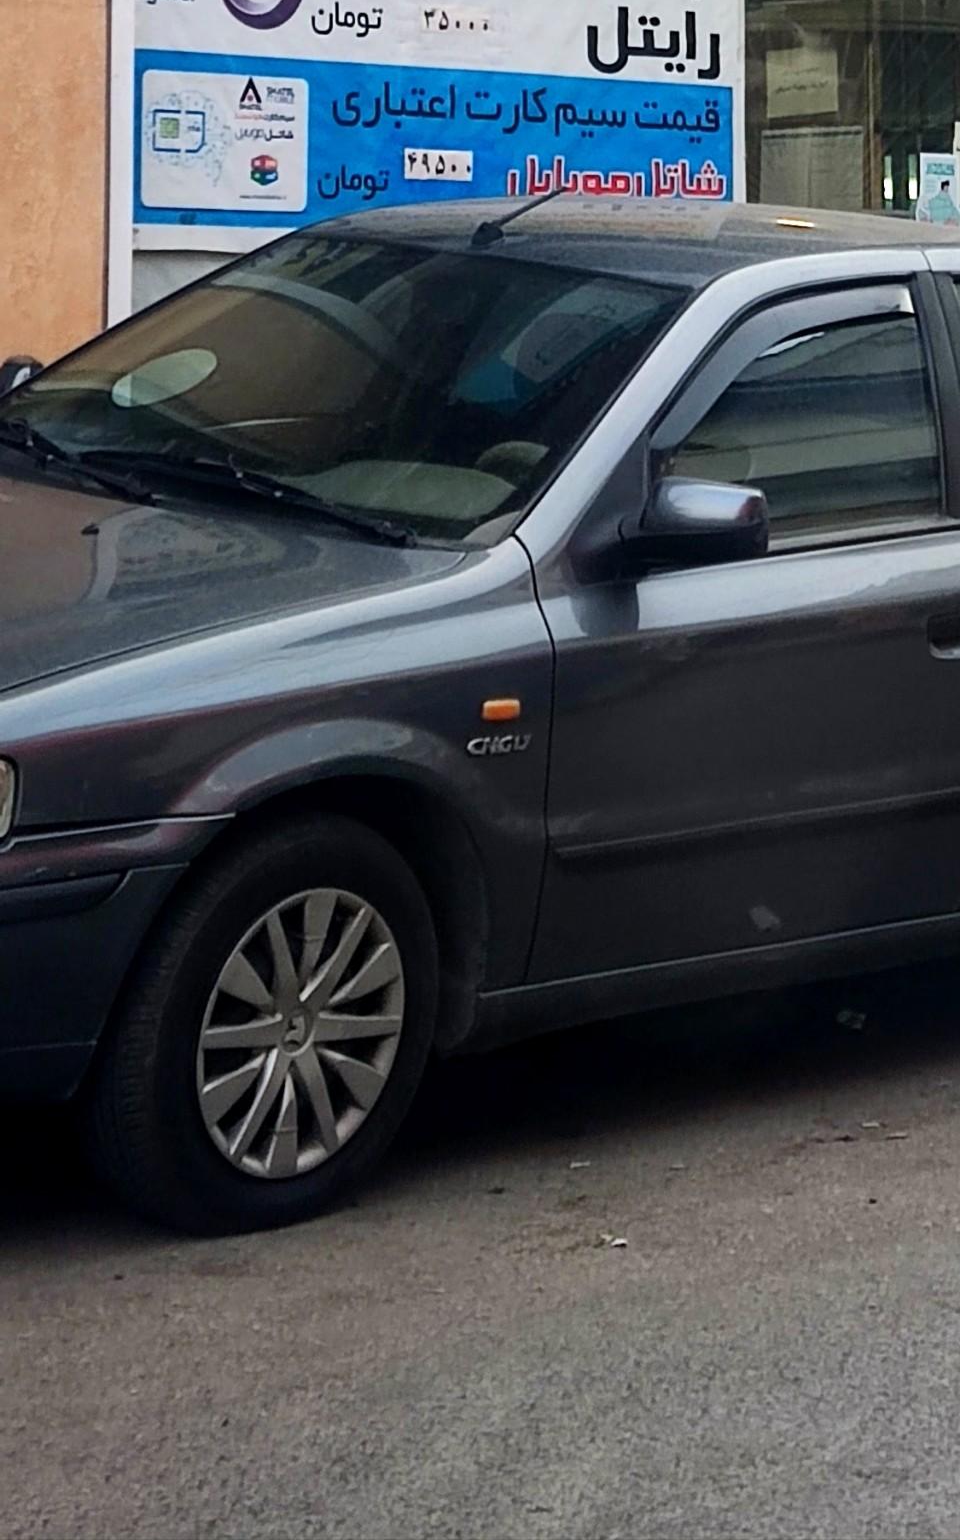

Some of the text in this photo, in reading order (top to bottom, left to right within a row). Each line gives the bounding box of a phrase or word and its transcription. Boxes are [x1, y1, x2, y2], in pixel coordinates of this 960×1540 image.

[311, 1, 383, 37] تومان
[586, 6, 721, 80] رایتل
[331, 80, 721, 144] قیمت سیم کارت اعتباری
[317, 164, 390, 199] تومان
[407, 152, 471, 175] ۴۹۵۰۰
